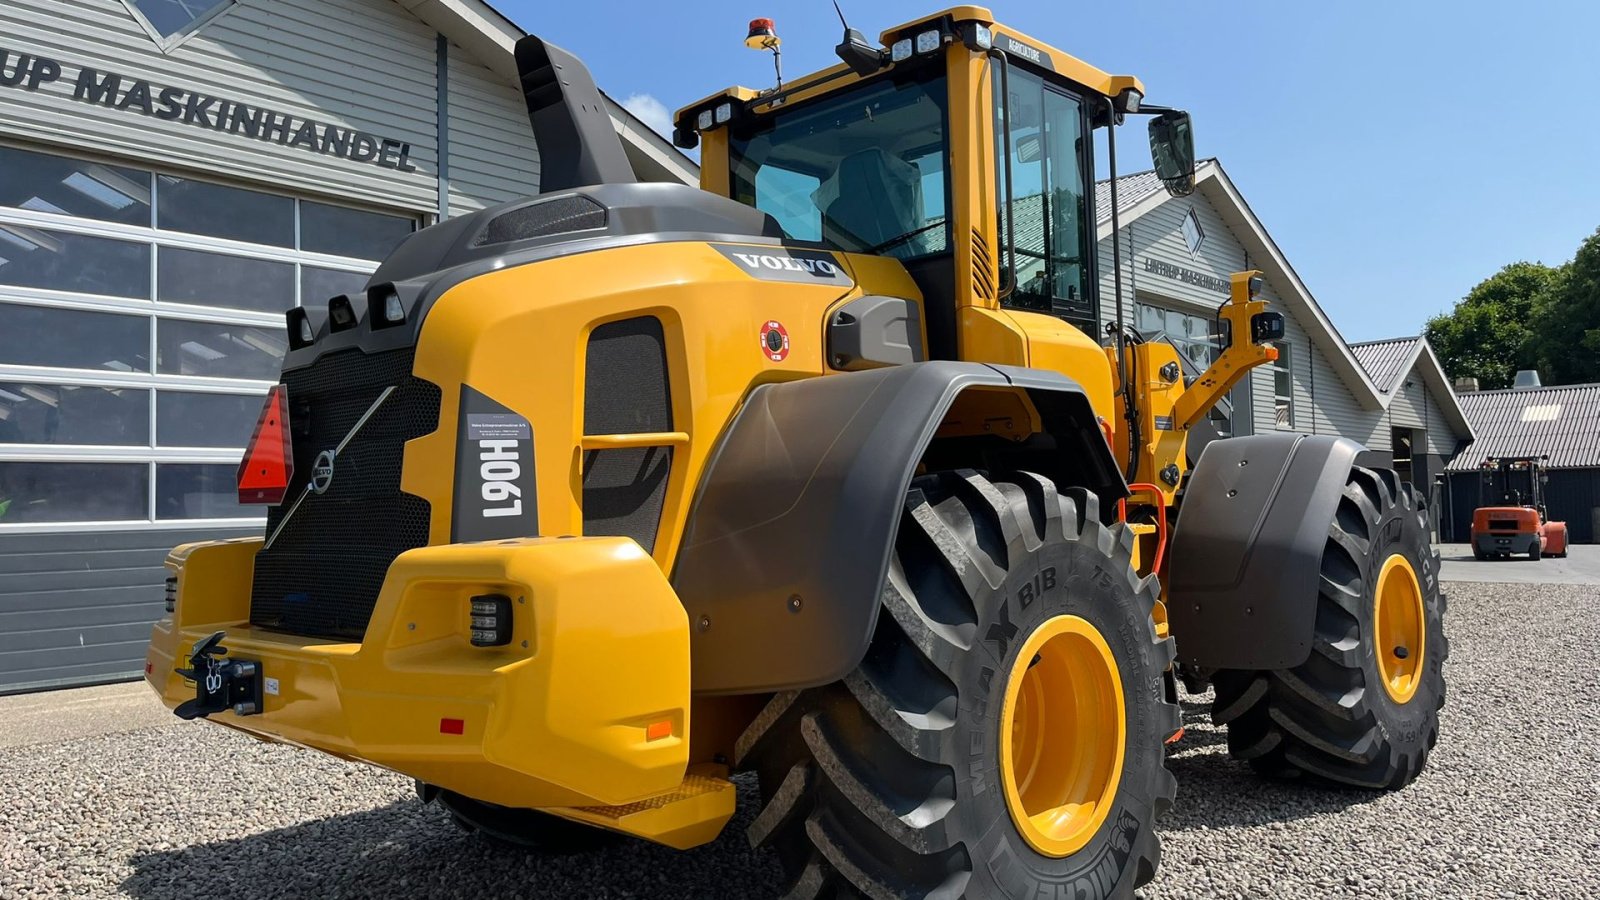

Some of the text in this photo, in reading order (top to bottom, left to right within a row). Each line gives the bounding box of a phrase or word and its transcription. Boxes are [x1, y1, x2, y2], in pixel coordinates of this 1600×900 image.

[1008, 38, 1040, 63] AGRICULTURE
[73, 67, 416, 174] MASKINHANDEL
[732, 252, 836, 275] VOLVO
[479, 439, 522, 517] L90H
[1017, 566, 1057, 611] BIB
